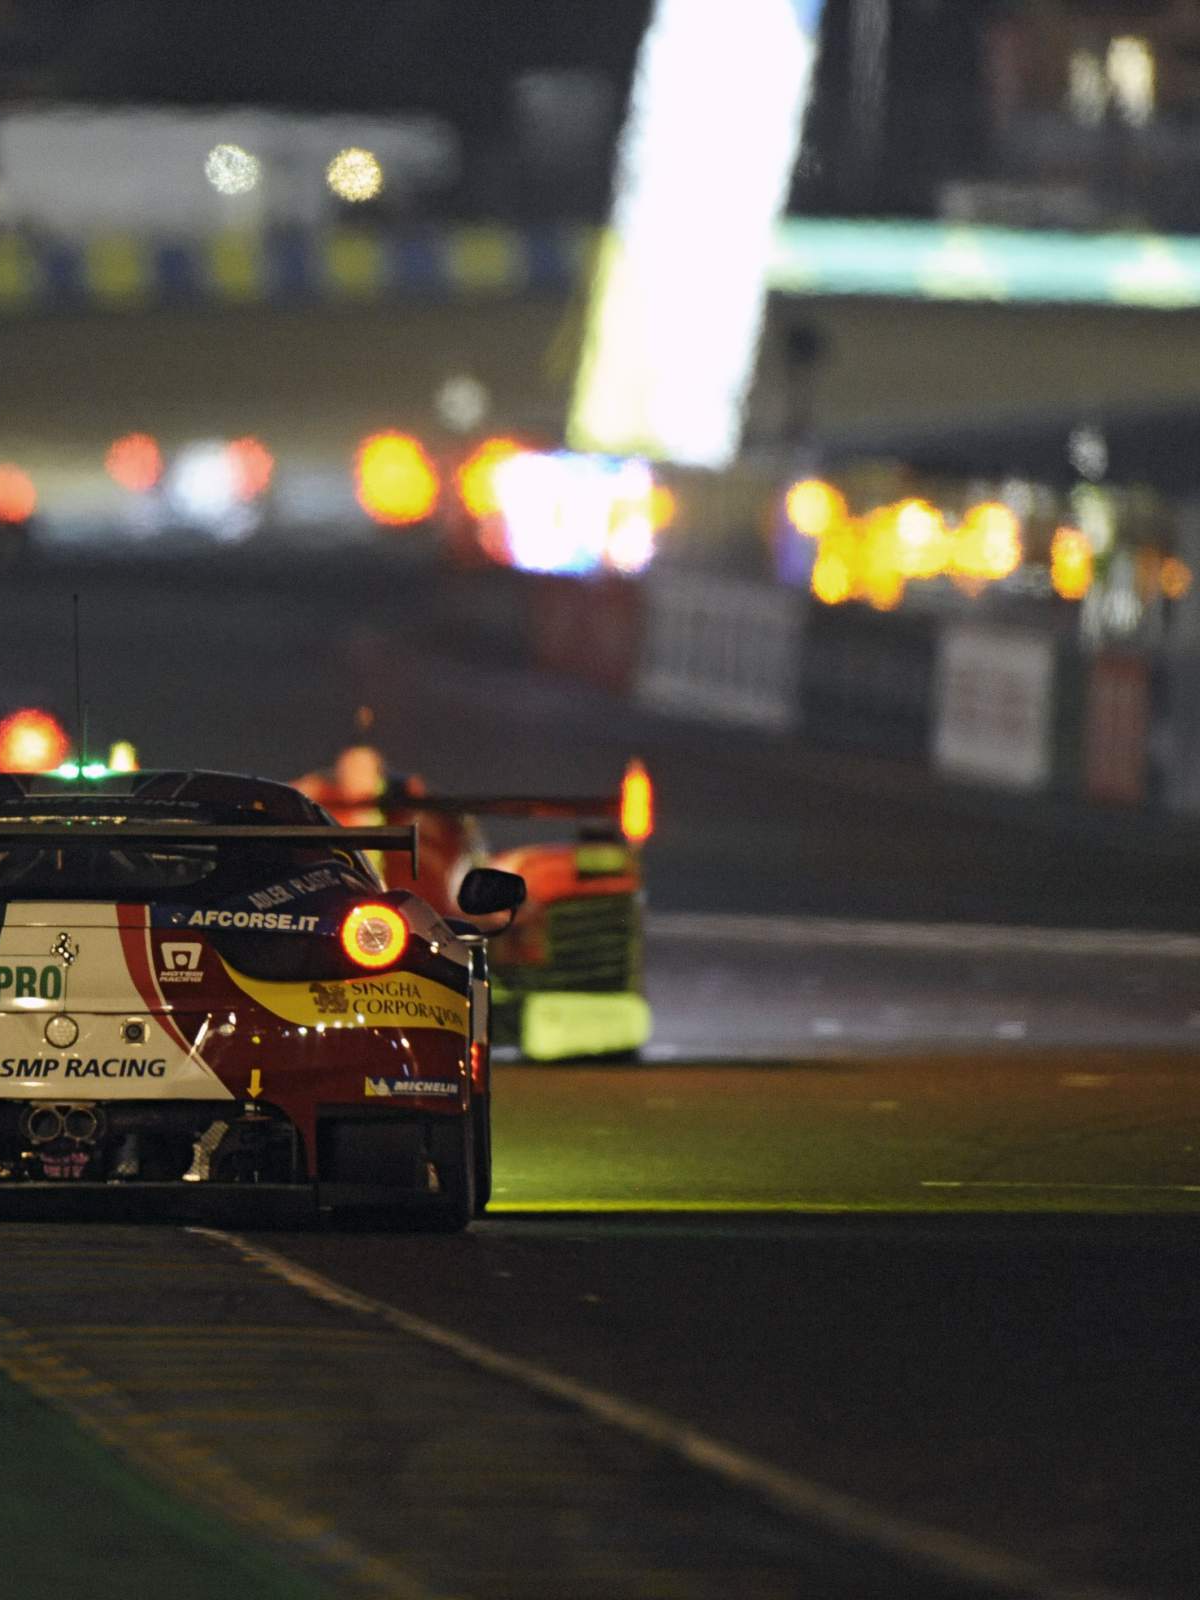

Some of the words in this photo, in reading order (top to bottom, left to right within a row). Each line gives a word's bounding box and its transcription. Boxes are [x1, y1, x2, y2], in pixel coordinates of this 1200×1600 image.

[188, 910, 320, 931] AFCORSE.IT
[351, 983, 422, 999] SINGHA
[352, 999, 464, 1027] CORPORATION
[0, 1058, 59, 1077] SMP
[64, 1058, 167, 1078] RACING
[394, 1081, 458, 1094] MICHELIN
